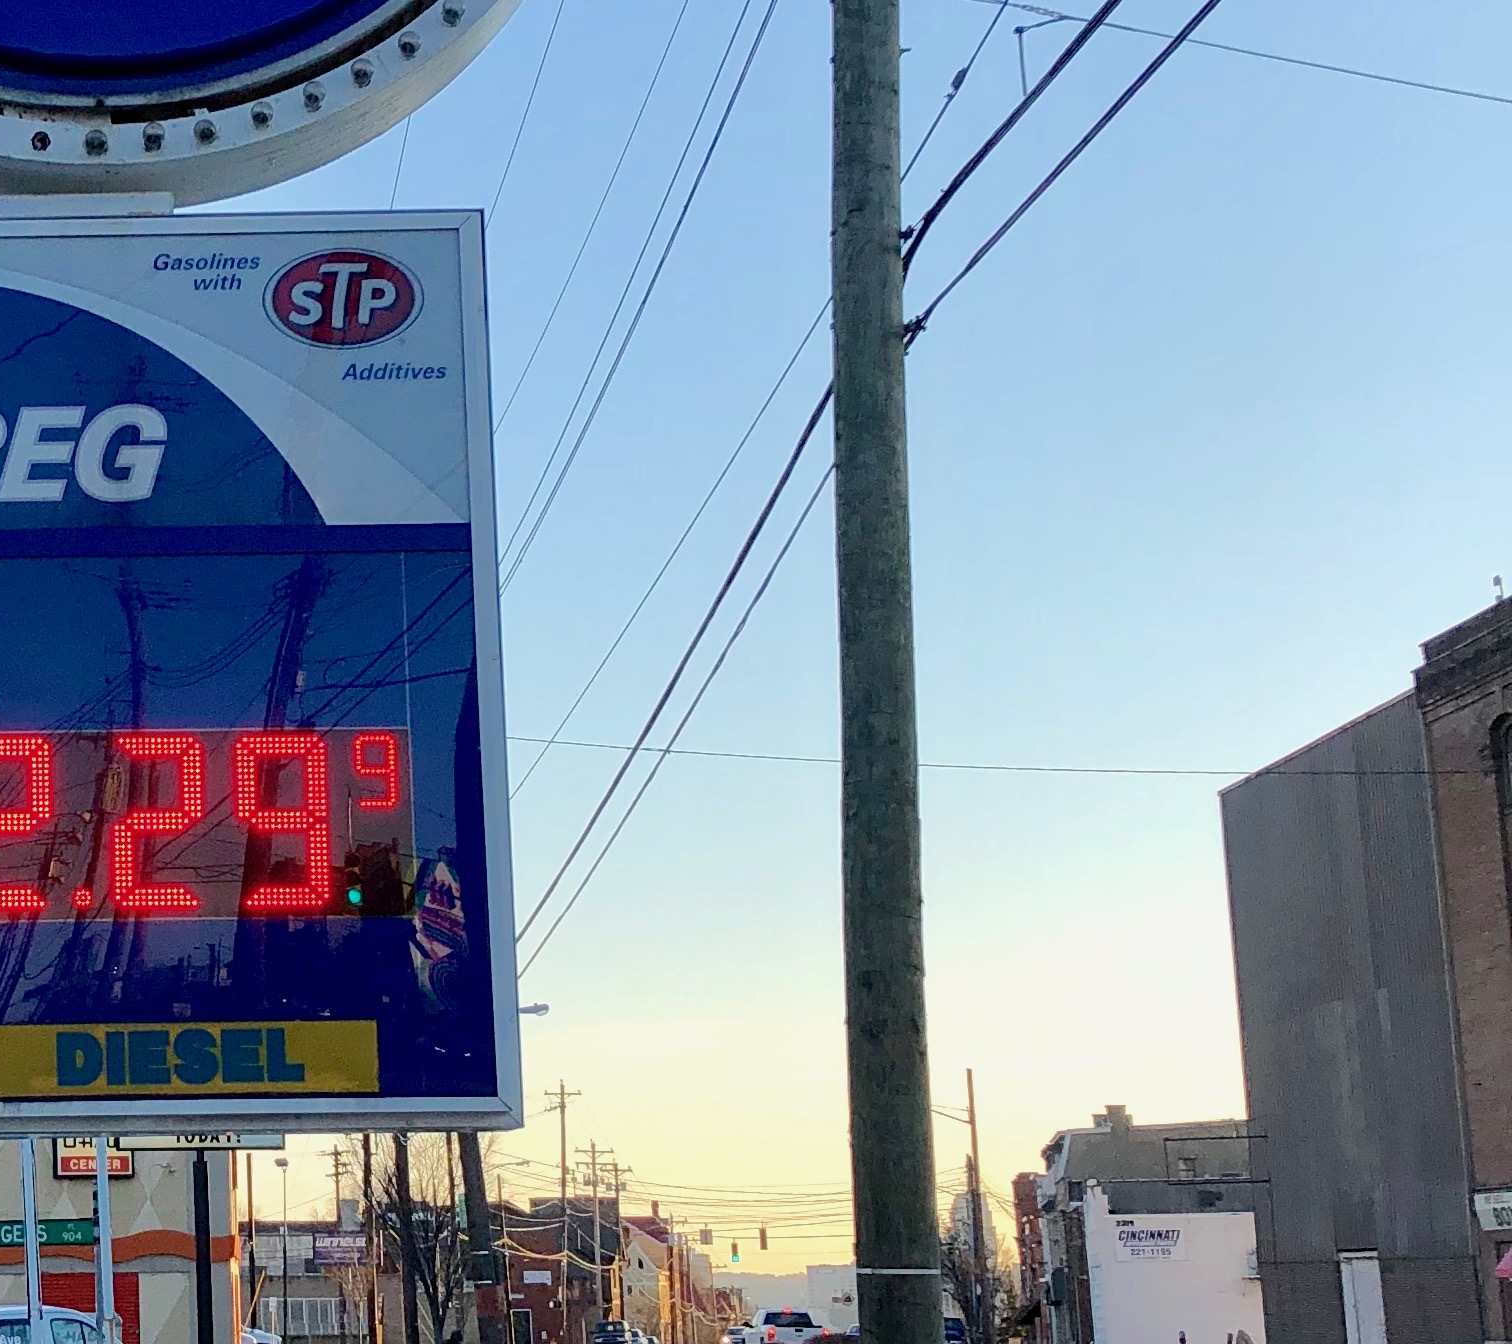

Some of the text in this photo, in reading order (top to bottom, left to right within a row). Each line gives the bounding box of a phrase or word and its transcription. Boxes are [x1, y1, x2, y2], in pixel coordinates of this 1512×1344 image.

[152, 252, 261, 272] Gasolines
[192, 272, 243, 292] with
[287, 261, 397, 330] STP
[341, 361, 448, 382] Additives
[350, 732, 402, 810] 9
[55, 1027, 306, 1088] DIESEL
[69, 1158, 121, 1170] CENER
[62, 1231, 82, 1242] 904
[1118, 1229, 1181, 1242] CINCINNATI
